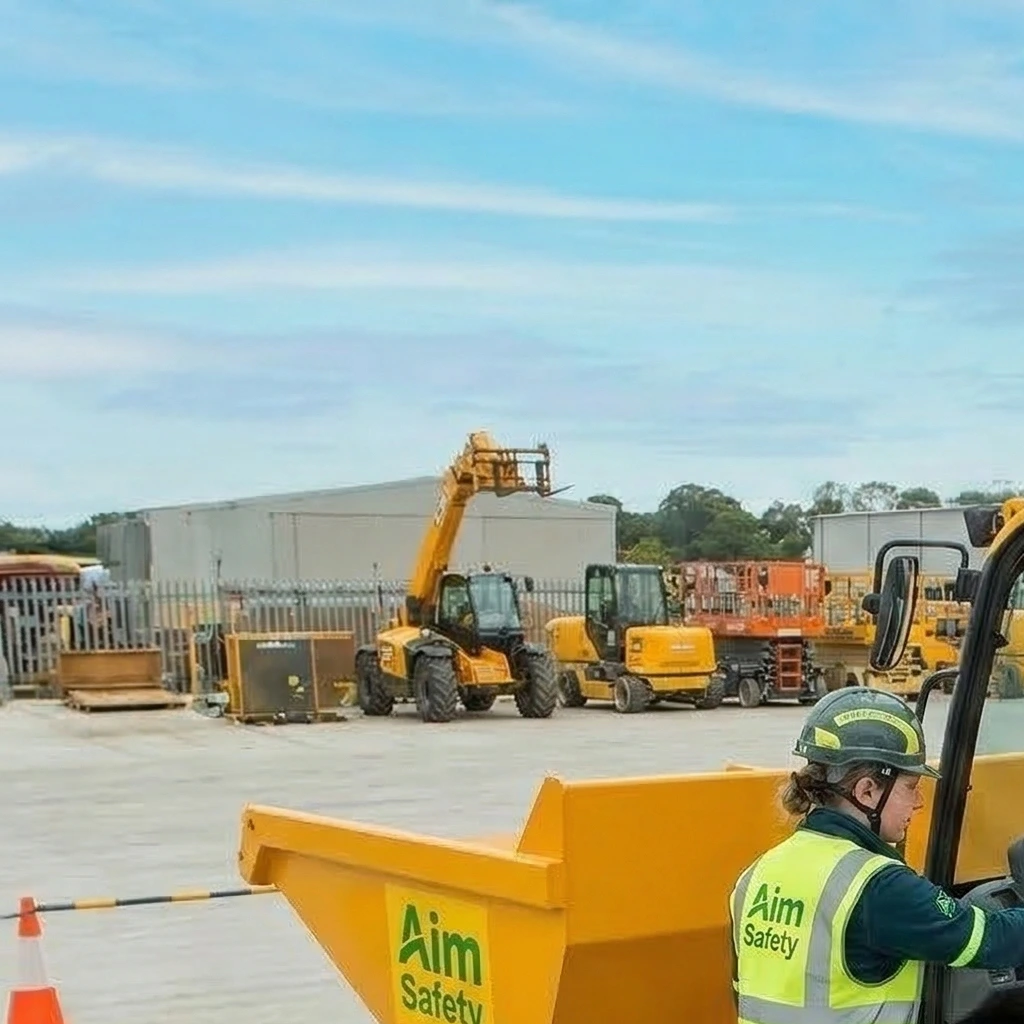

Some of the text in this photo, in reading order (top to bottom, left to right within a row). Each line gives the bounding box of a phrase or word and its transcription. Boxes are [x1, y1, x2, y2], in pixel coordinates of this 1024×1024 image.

[747, 883, 804, 927] Aim
[399, 904, 482, 986] Aim
[744, 923, 799, 960] Safety
